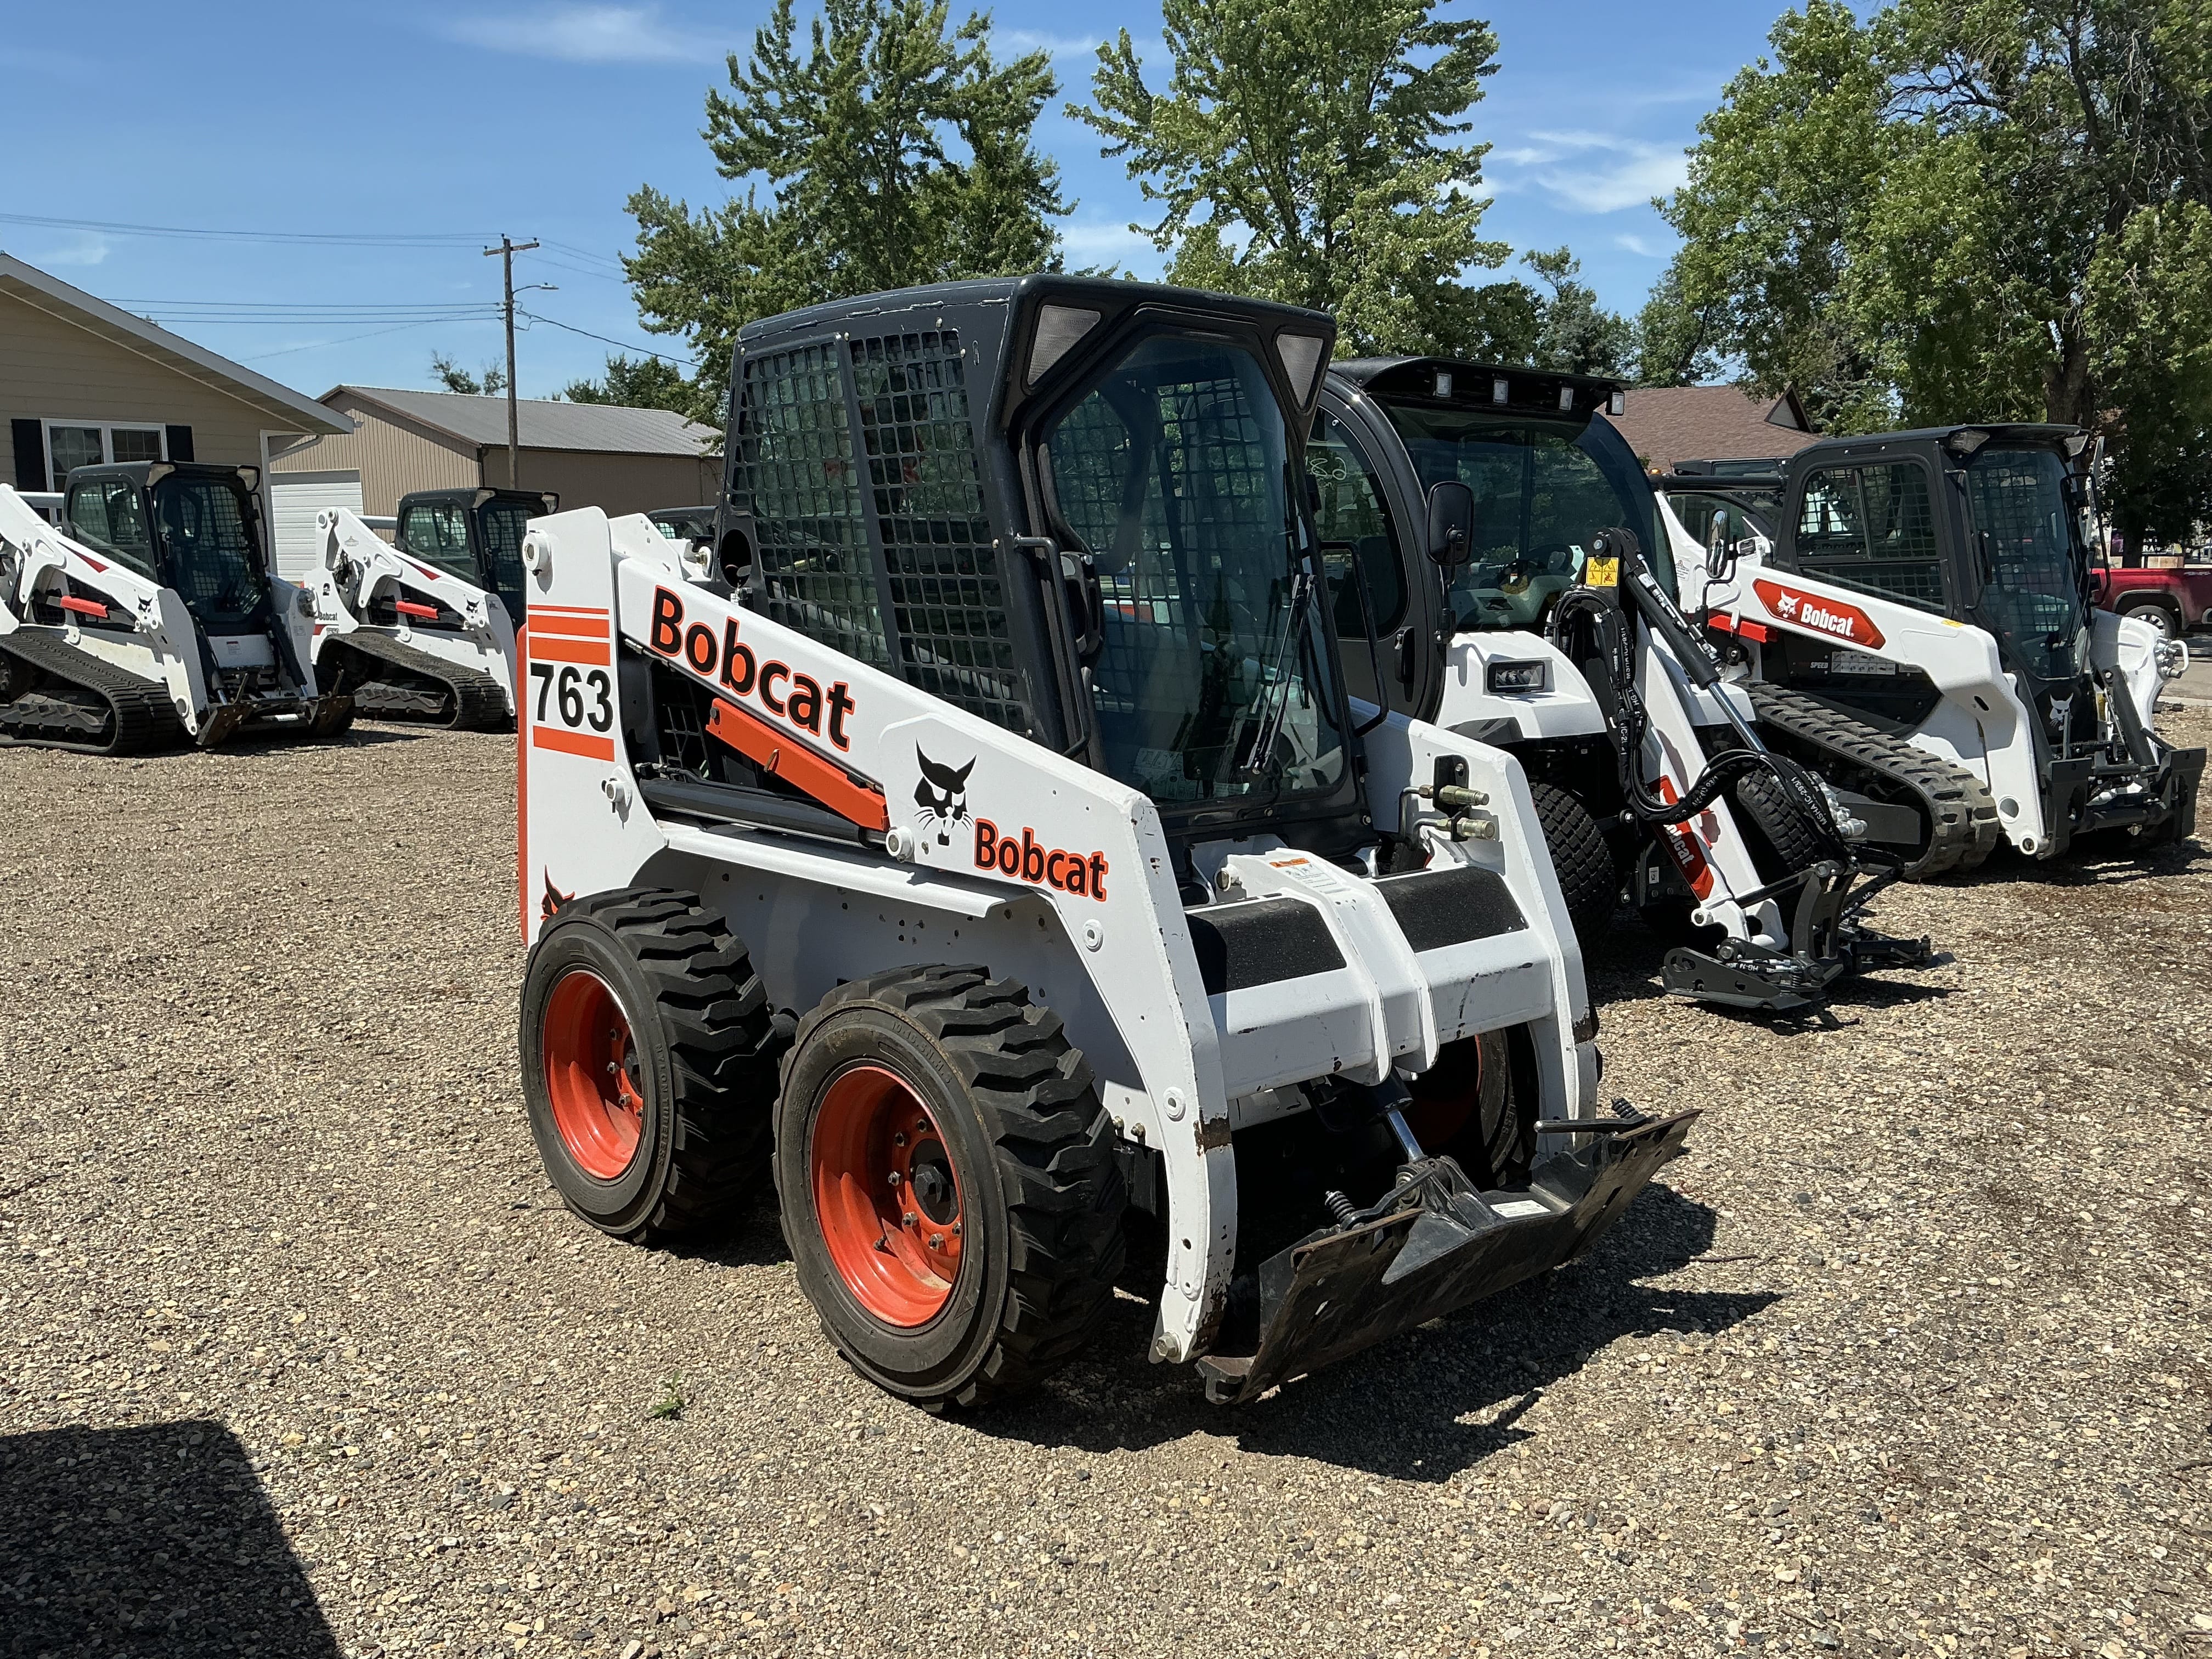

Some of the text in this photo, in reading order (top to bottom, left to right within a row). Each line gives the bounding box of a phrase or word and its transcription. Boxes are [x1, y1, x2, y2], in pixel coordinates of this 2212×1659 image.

[1801, 603, 1854, 637] Bobcat
[650, 584, 856, 752] Bobcat
[529, 662, 613, 732] 763
[1791, 776, 1813, 805] IC-293/1
[1810, 803, 1827, 825] MSHA
[974, 817, 1109, 902] Bobcat
[1663, 824, 1695, 866] obcat
